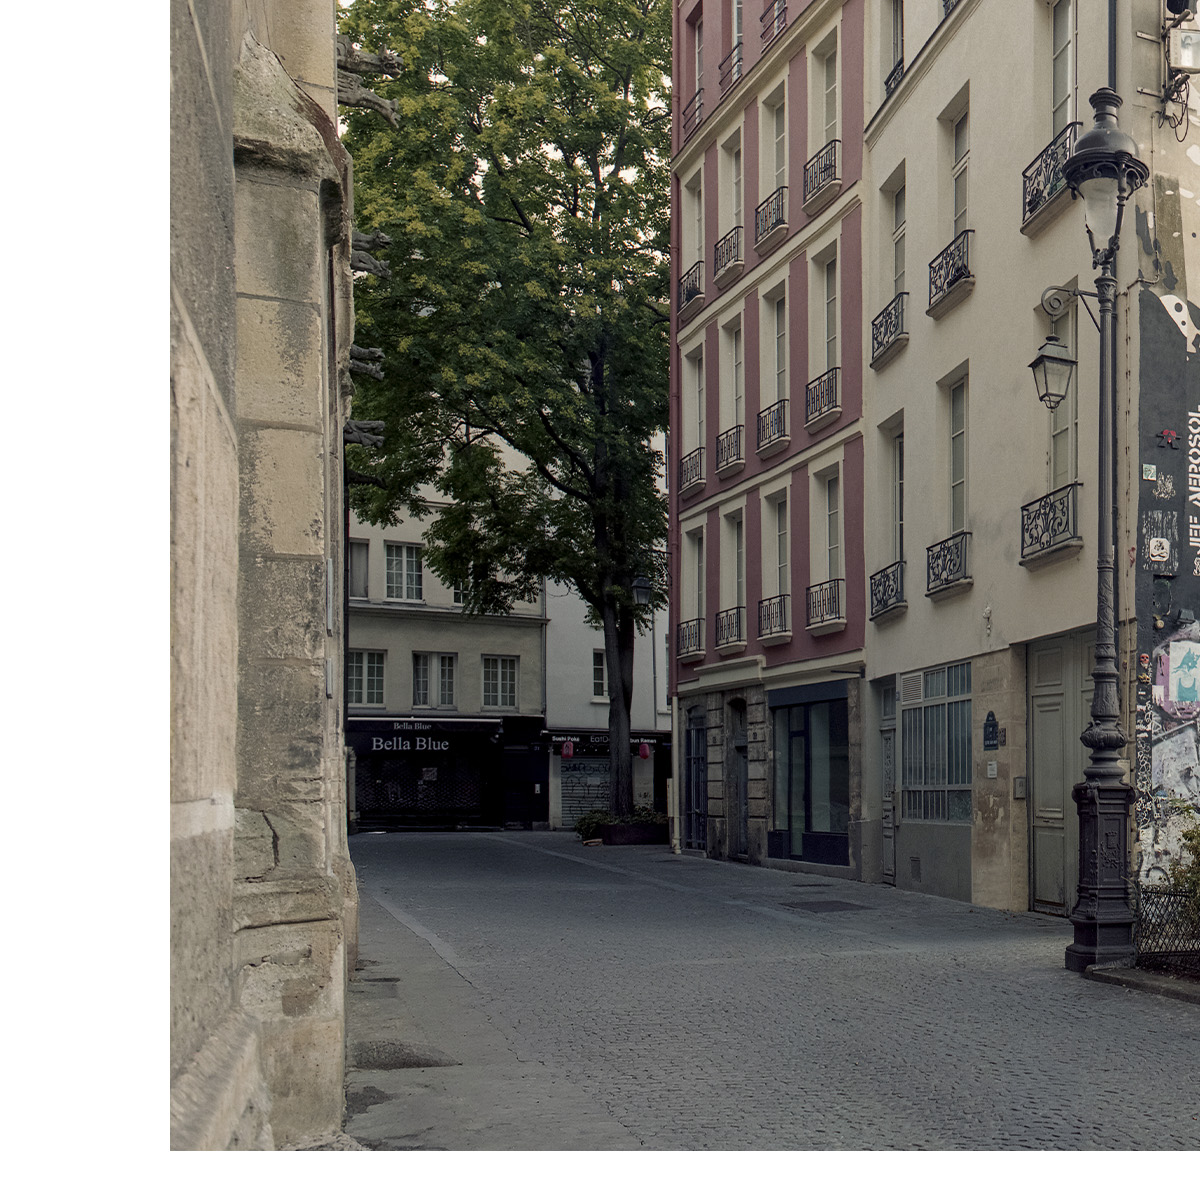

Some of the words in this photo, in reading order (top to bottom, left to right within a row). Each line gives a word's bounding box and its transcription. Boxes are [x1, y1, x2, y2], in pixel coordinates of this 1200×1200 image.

[393, 722, 413, 730] Bella
[414, 722, 432, 730] Blue
[371, 737, 411, 751] Bella
[415, 737, 449, 751] Blue
